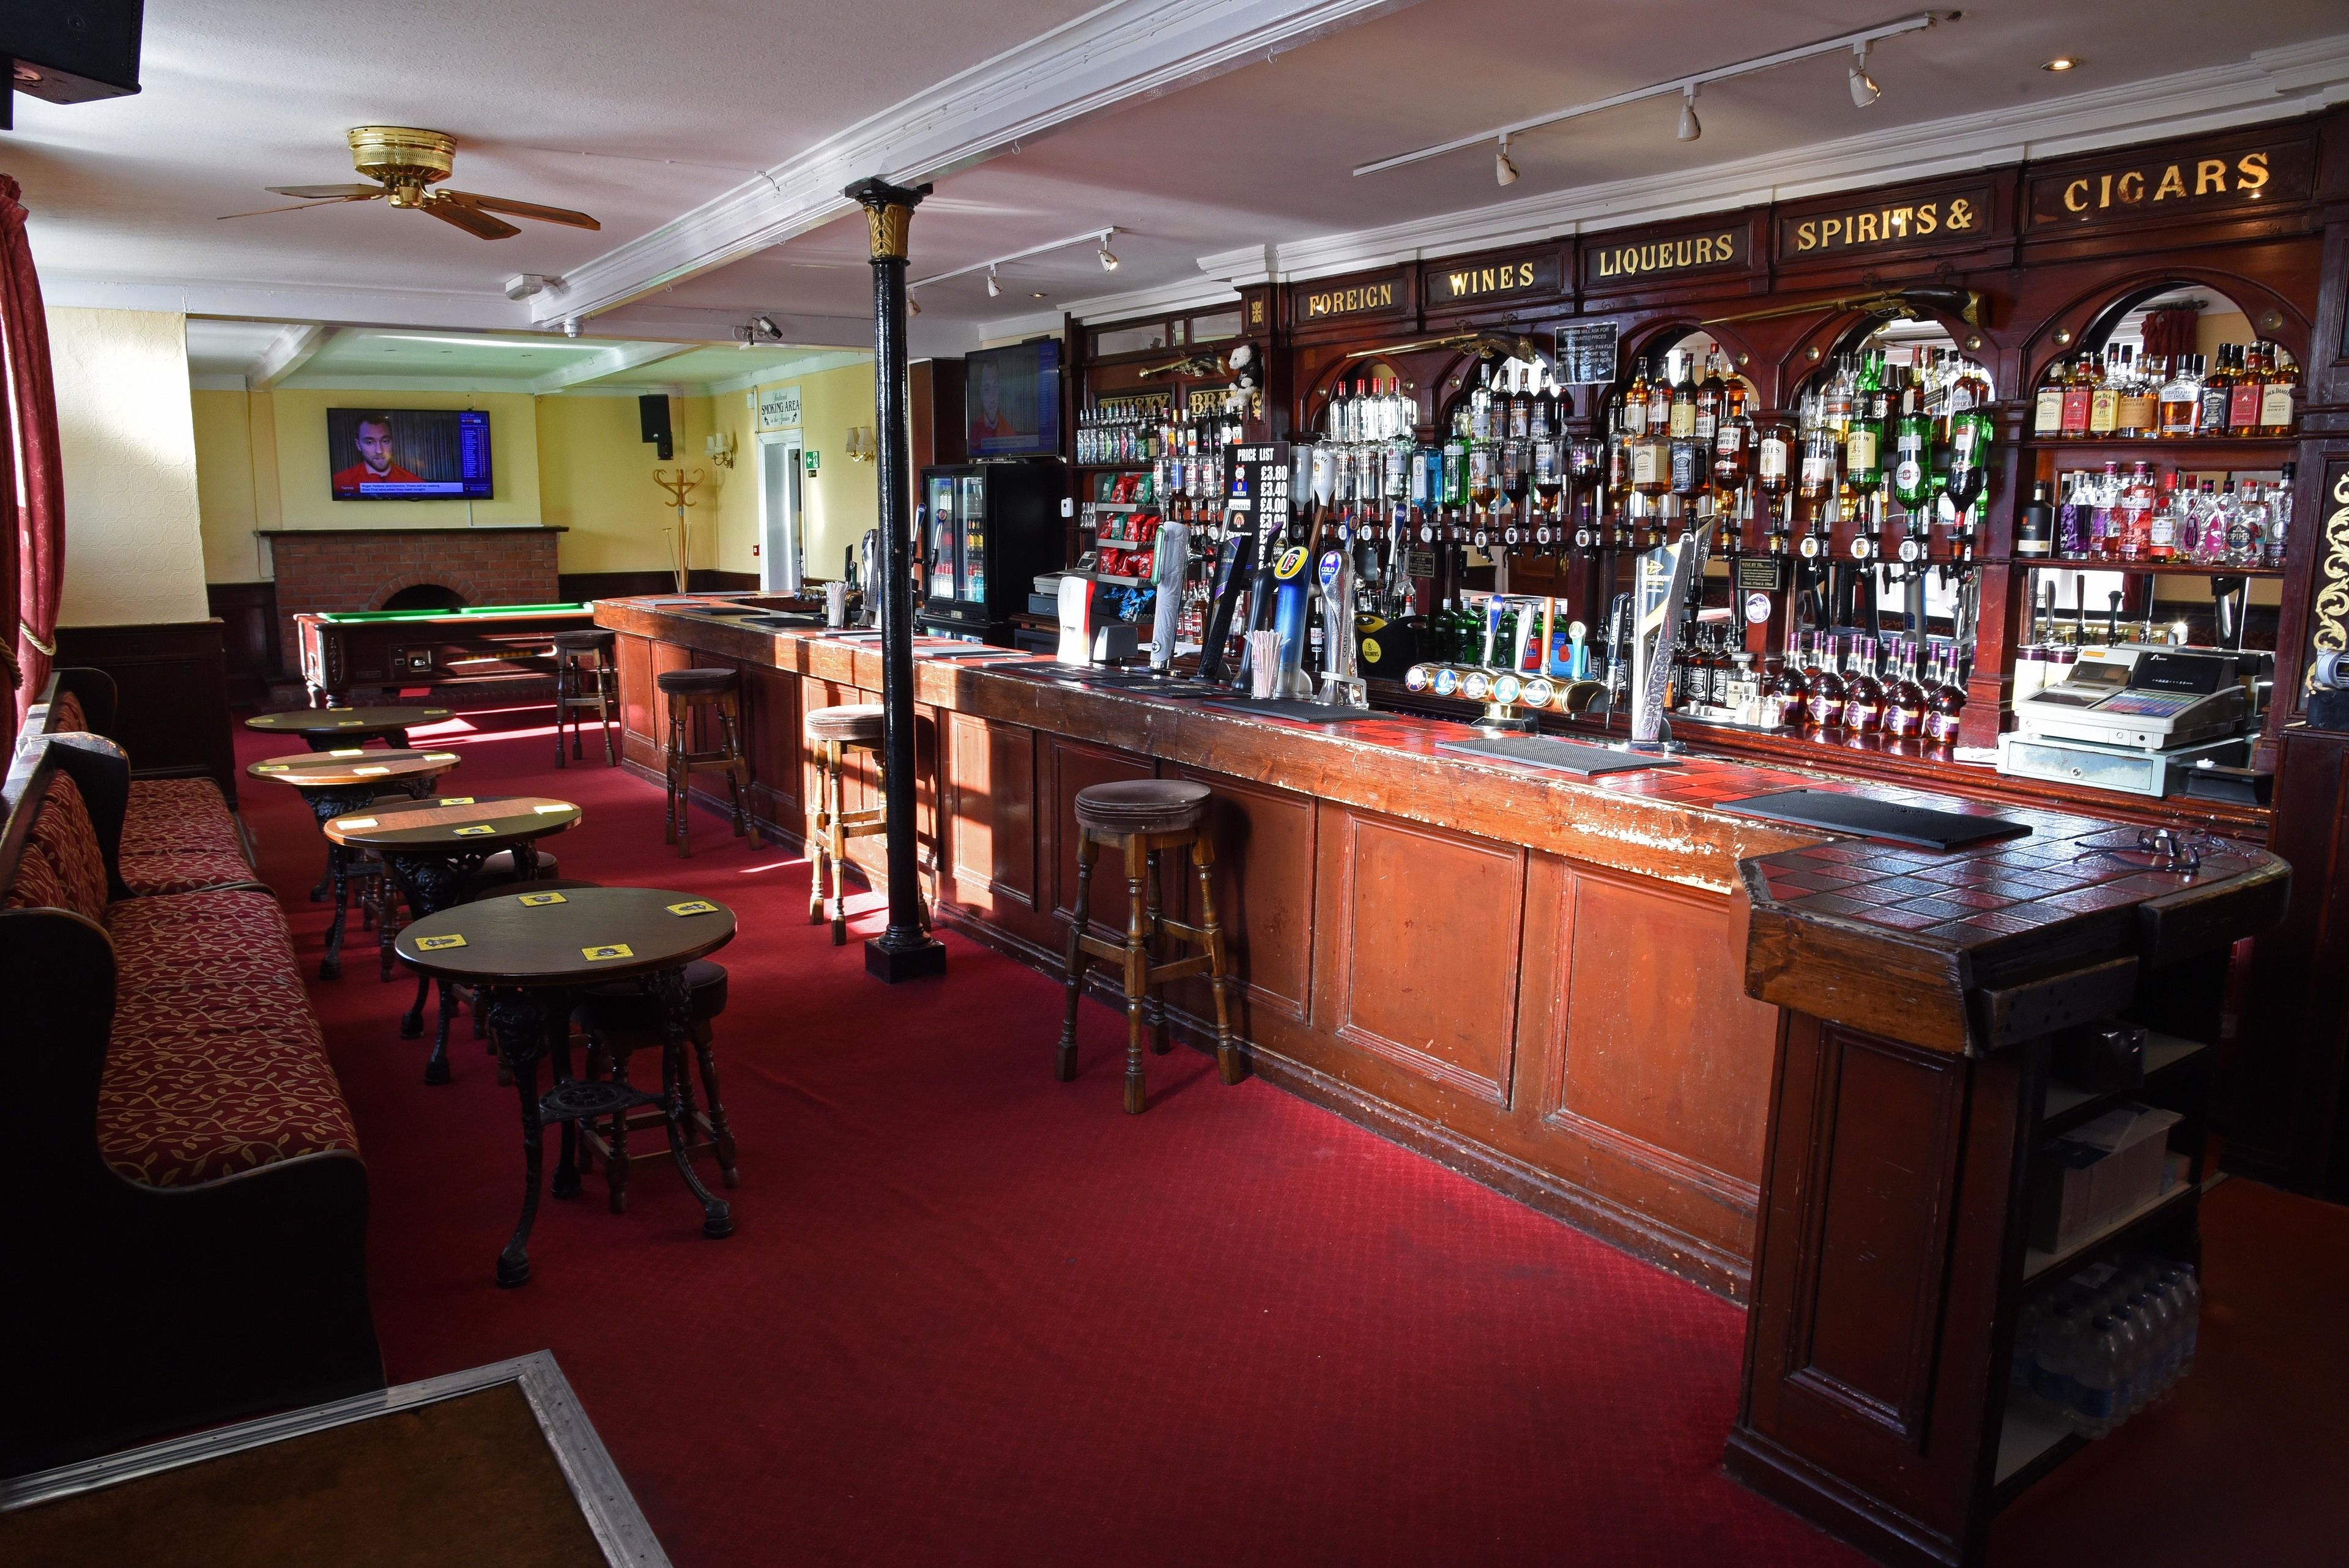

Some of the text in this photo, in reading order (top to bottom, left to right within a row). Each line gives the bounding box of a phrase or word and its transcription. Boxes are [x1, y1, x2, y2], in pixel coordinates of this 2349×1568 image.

[2063, 152, 2271, 212] CIGARS
[1796, 199, 1973, 252] SPIRITS &
[1598, 234, 1735, 278] LIQUEURS
[1450, 262, 1535, 297] WINES
[1309, 283, 1392, 317] FOREIGN
[2093, 394, 2102, 403] JIM
[2275, 387, 2291, 397] DANIEL
[762, 399, 800, 415] SMOKING AREA
[1191, 392, 1238, 415] BRA
[1237, 447, 1274, 461] PRICE LIST
[1260, 466, 1288, 481] £3.80
[1260, 481, 1288, 497] £3.40
[1260, 497, 1287, 513] £4.00
